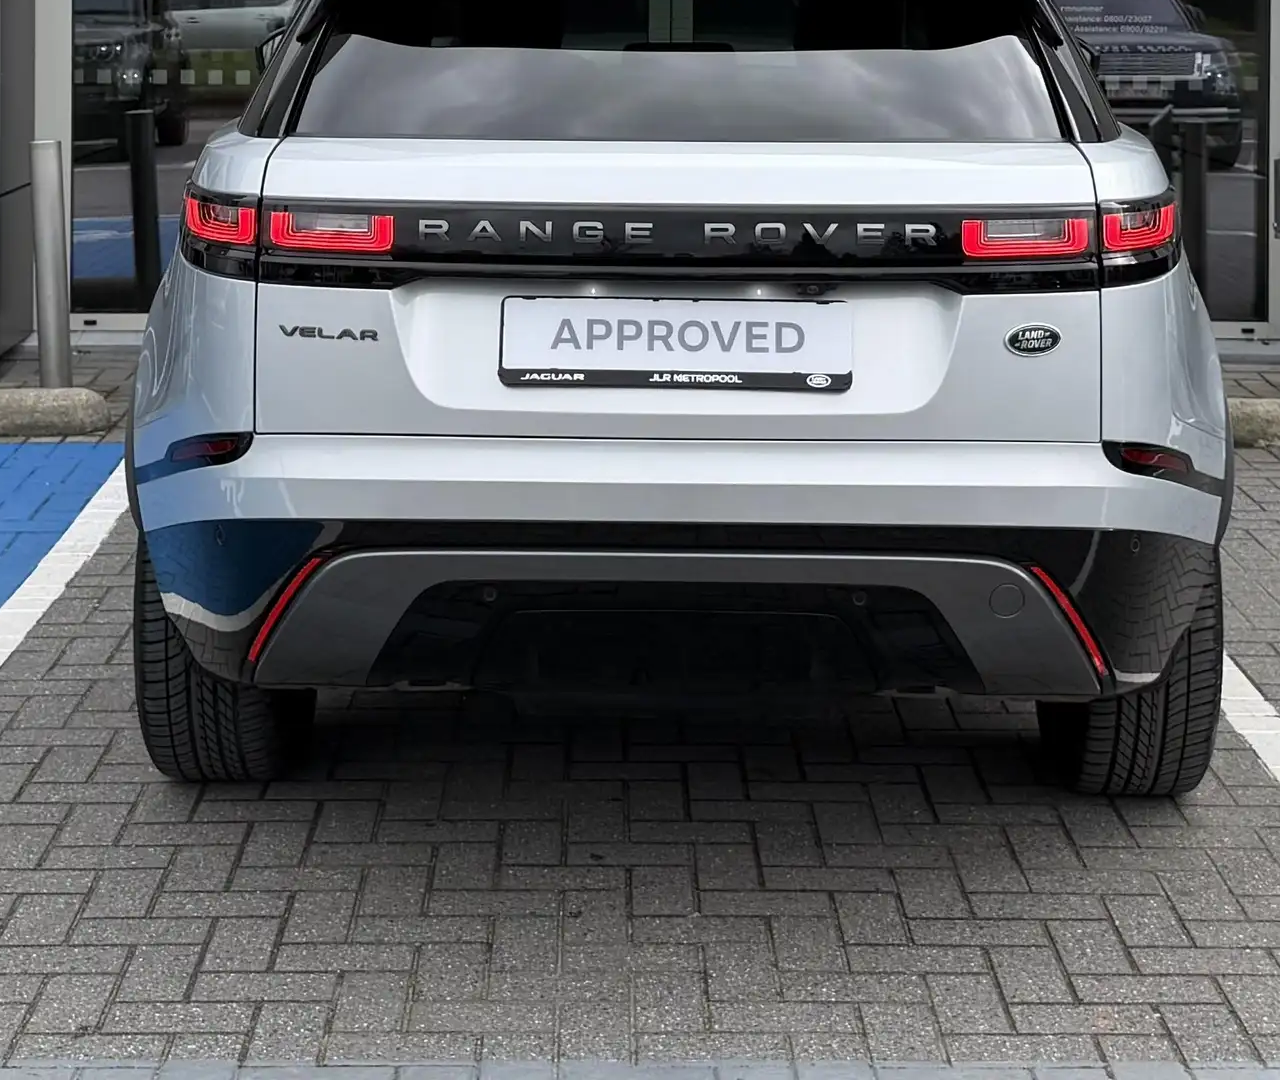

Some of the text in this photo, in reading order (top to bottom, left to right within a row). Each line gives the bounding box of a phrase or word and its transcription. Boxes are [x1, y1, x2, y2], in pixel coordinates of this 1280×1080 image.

[419, 220, 938, 247] RANGE ROVER
[278, 324, 379, 341] VELAR
[550, 317, 806, 354] APPROVED
[1018, 330, 1045, 340] LAND
[1020, 338, 1053, 349] ROVER
[520, 373, 585, 381] JAGUAR
[649, 373, 743, 384] JLR METROPOOL
